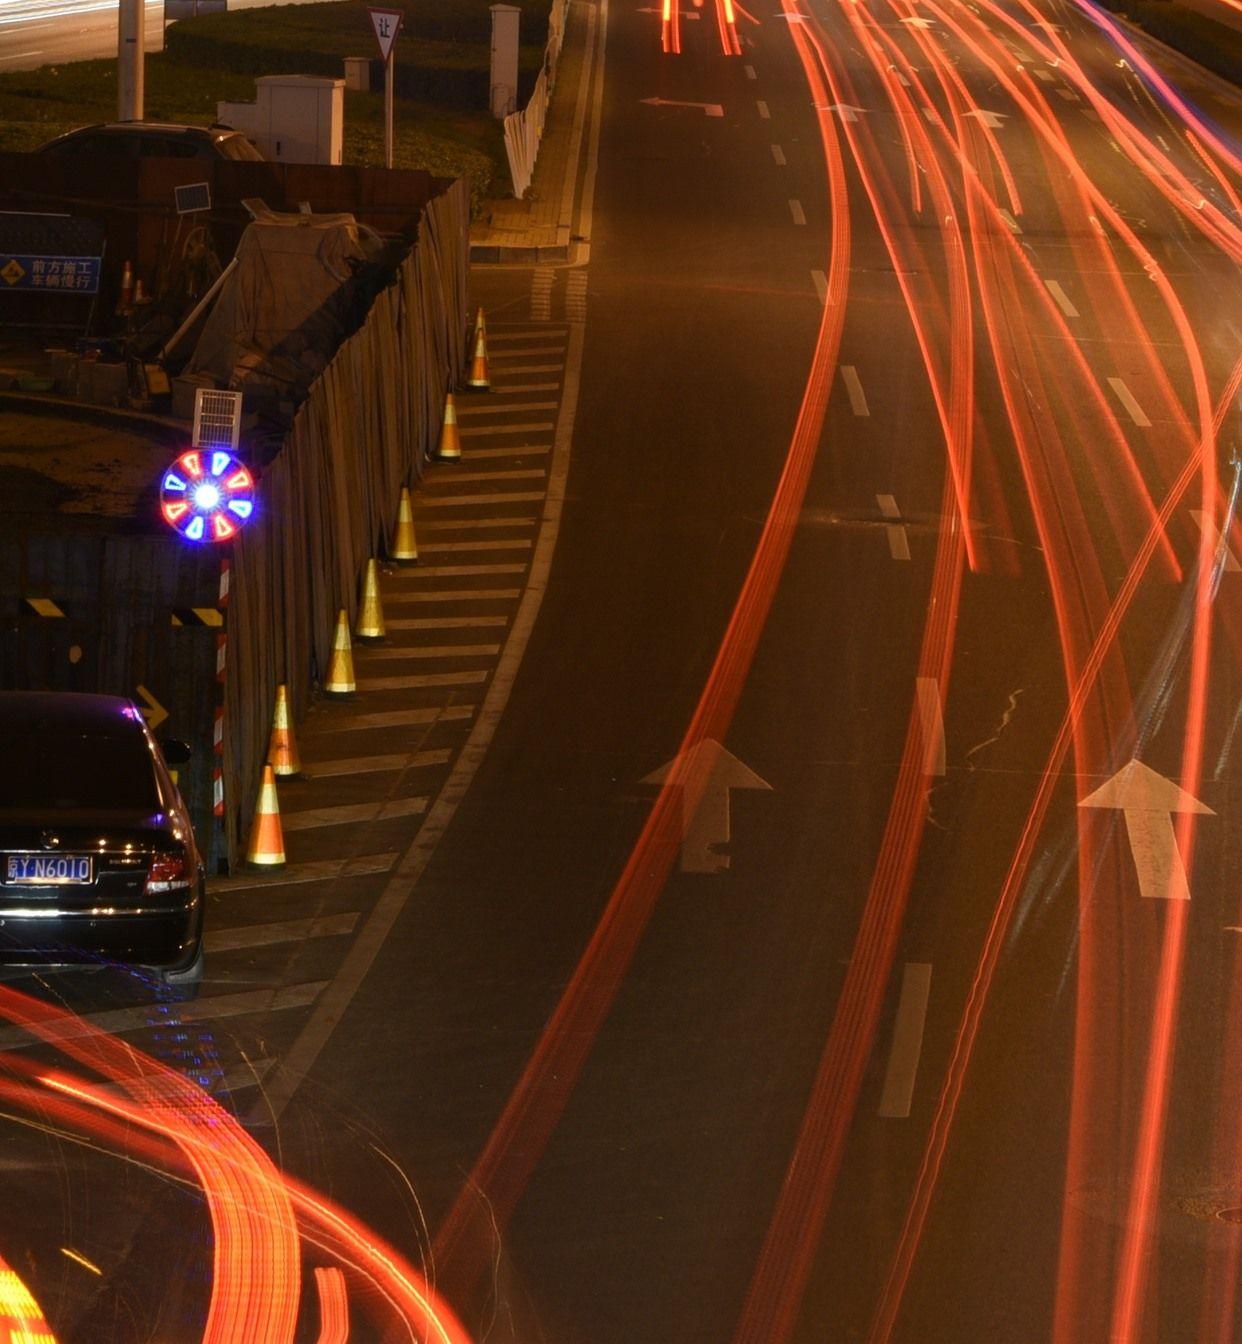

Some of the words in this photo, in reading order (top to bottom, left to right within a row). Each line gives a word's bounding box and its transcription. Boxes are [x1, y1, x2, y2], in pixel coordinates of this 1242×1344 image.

[379, 18, 390, 38] 让
[32, 259, 91, 275] 前方施工
[32, 274, 91, 289] 车辆慢行
